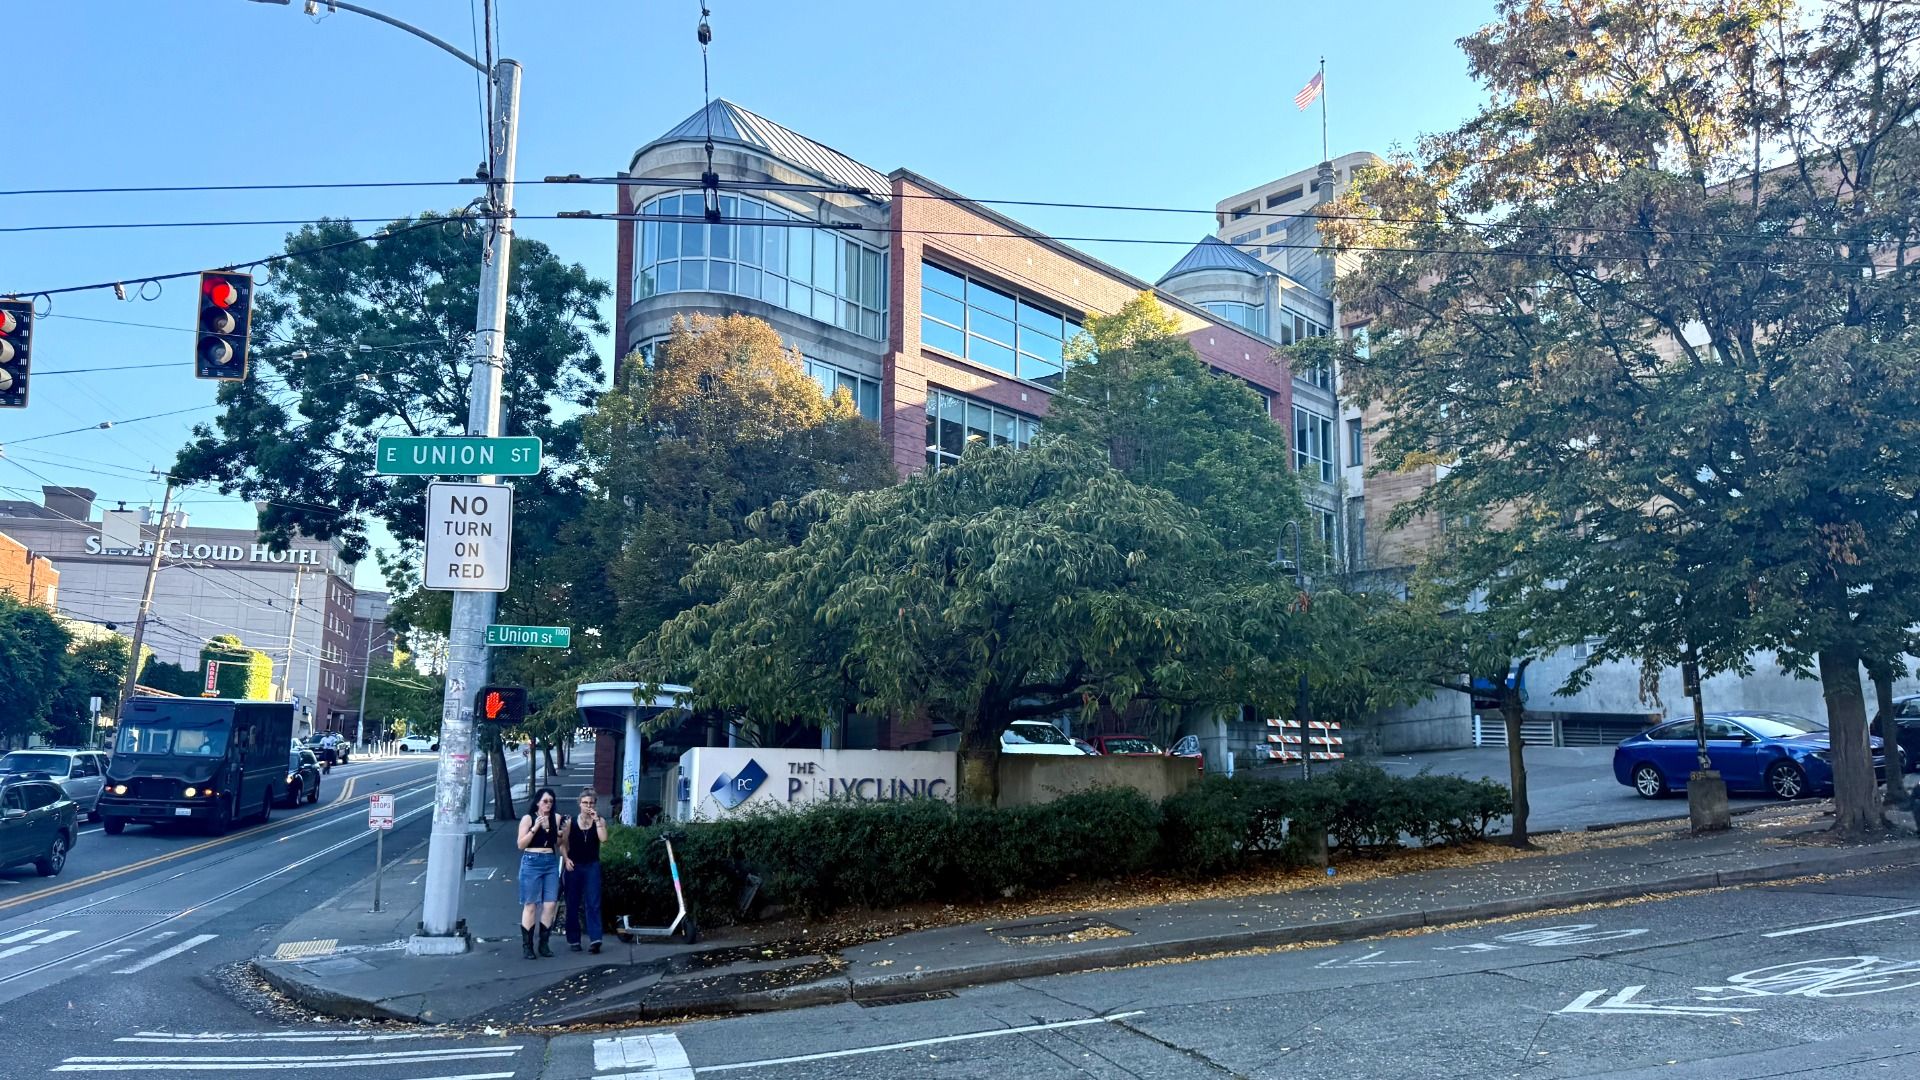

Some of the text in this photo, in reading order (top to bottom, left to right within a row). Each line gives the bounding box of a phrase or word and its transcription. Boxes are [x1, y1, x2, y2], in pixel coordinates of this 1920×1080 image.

[386, 445, 531, 464] E UNION ST
[450, 495, 488, 516] NO
[444, 521, 492, 537] TURN
[455, 542, 479, 558] ON
[449, 563, 485, 579] RED
[488, 625, 553, 644] E Union St
[555, 628, 569, 637] 1100
[788, 762, 814, 775] THE
[737, 779, 752, 791] PC
[788, 777, 947, 803] PLYCLINIC
